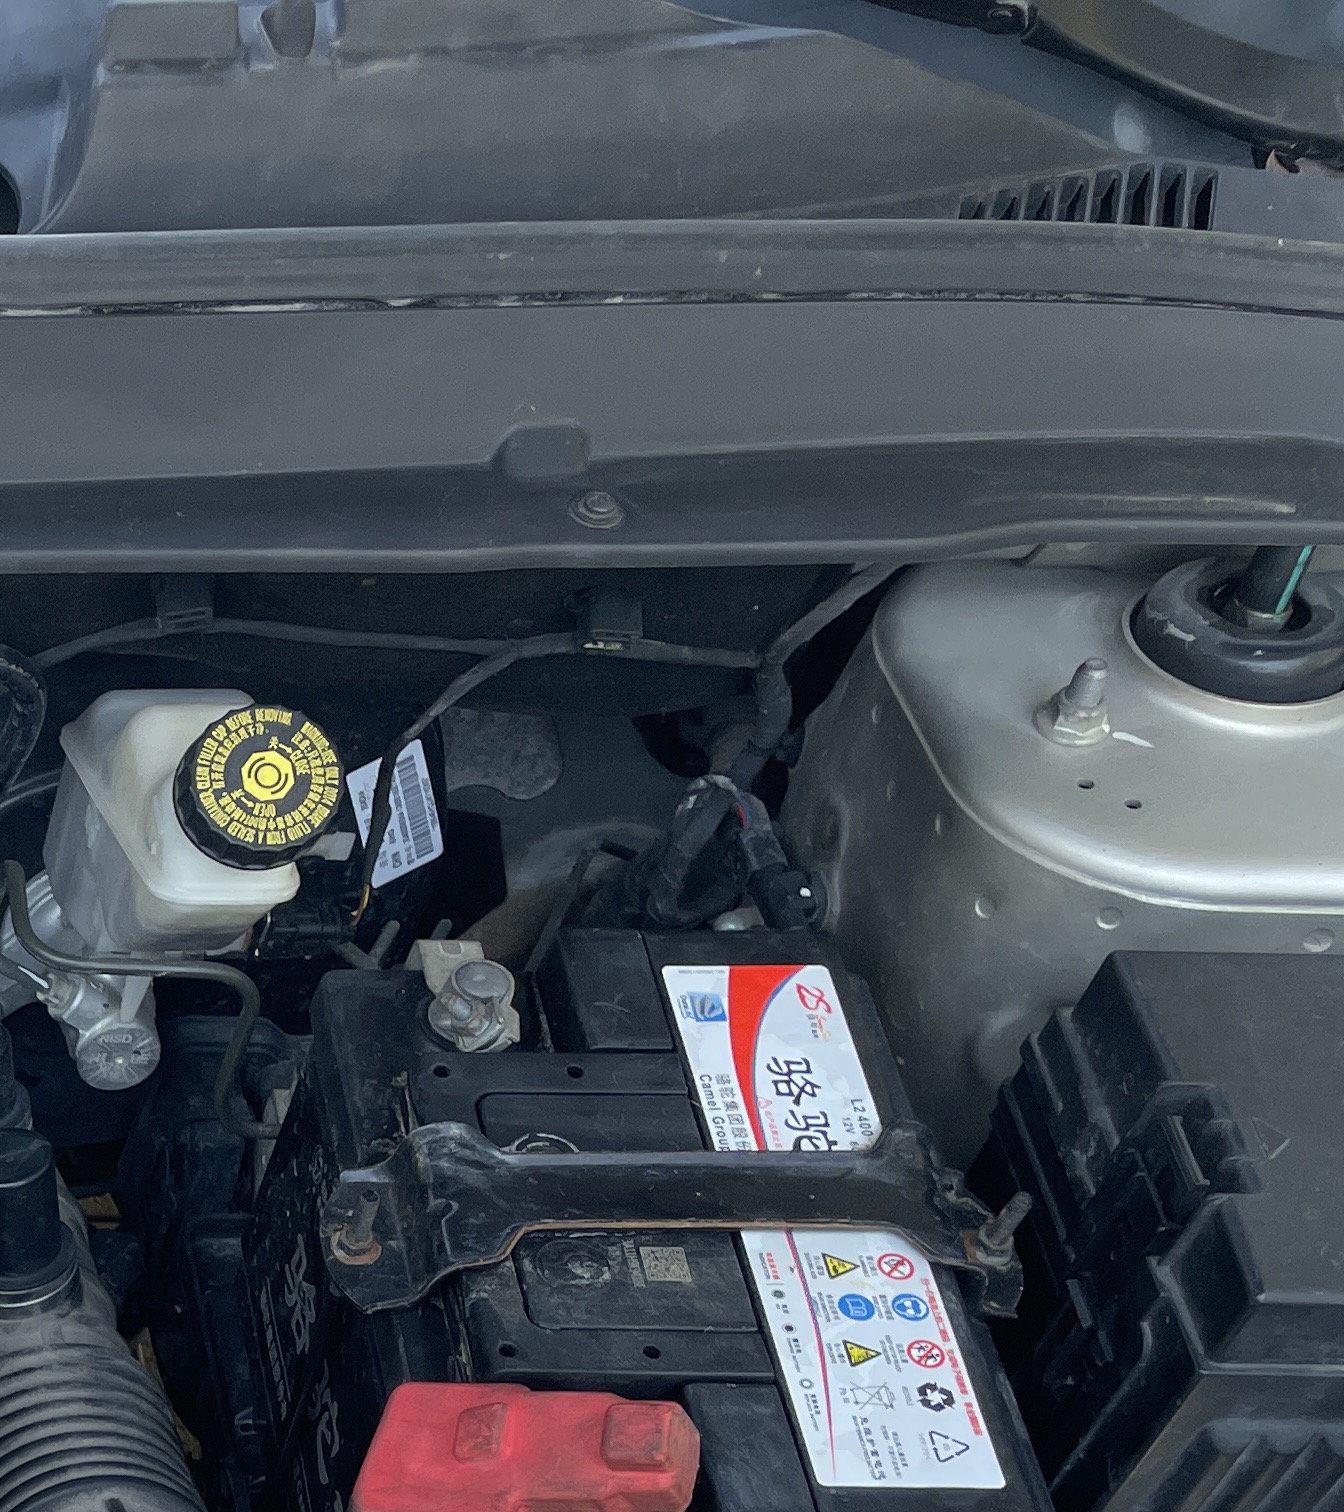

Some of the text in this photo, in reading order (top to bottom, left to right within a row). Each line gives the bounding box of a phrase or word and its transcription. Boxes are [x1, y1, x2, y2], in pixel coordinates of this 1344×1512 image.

[289, 750, 311, 775] CLOSE
[252, 803, 276, 816] OPEN
[700, 1075, 717, 1112] Camel
[767, 1056, 838, 1150] 骆驼
[842, 1117, 855, 1134] 12V
[851, 1098, 874, 1137] L2 400
